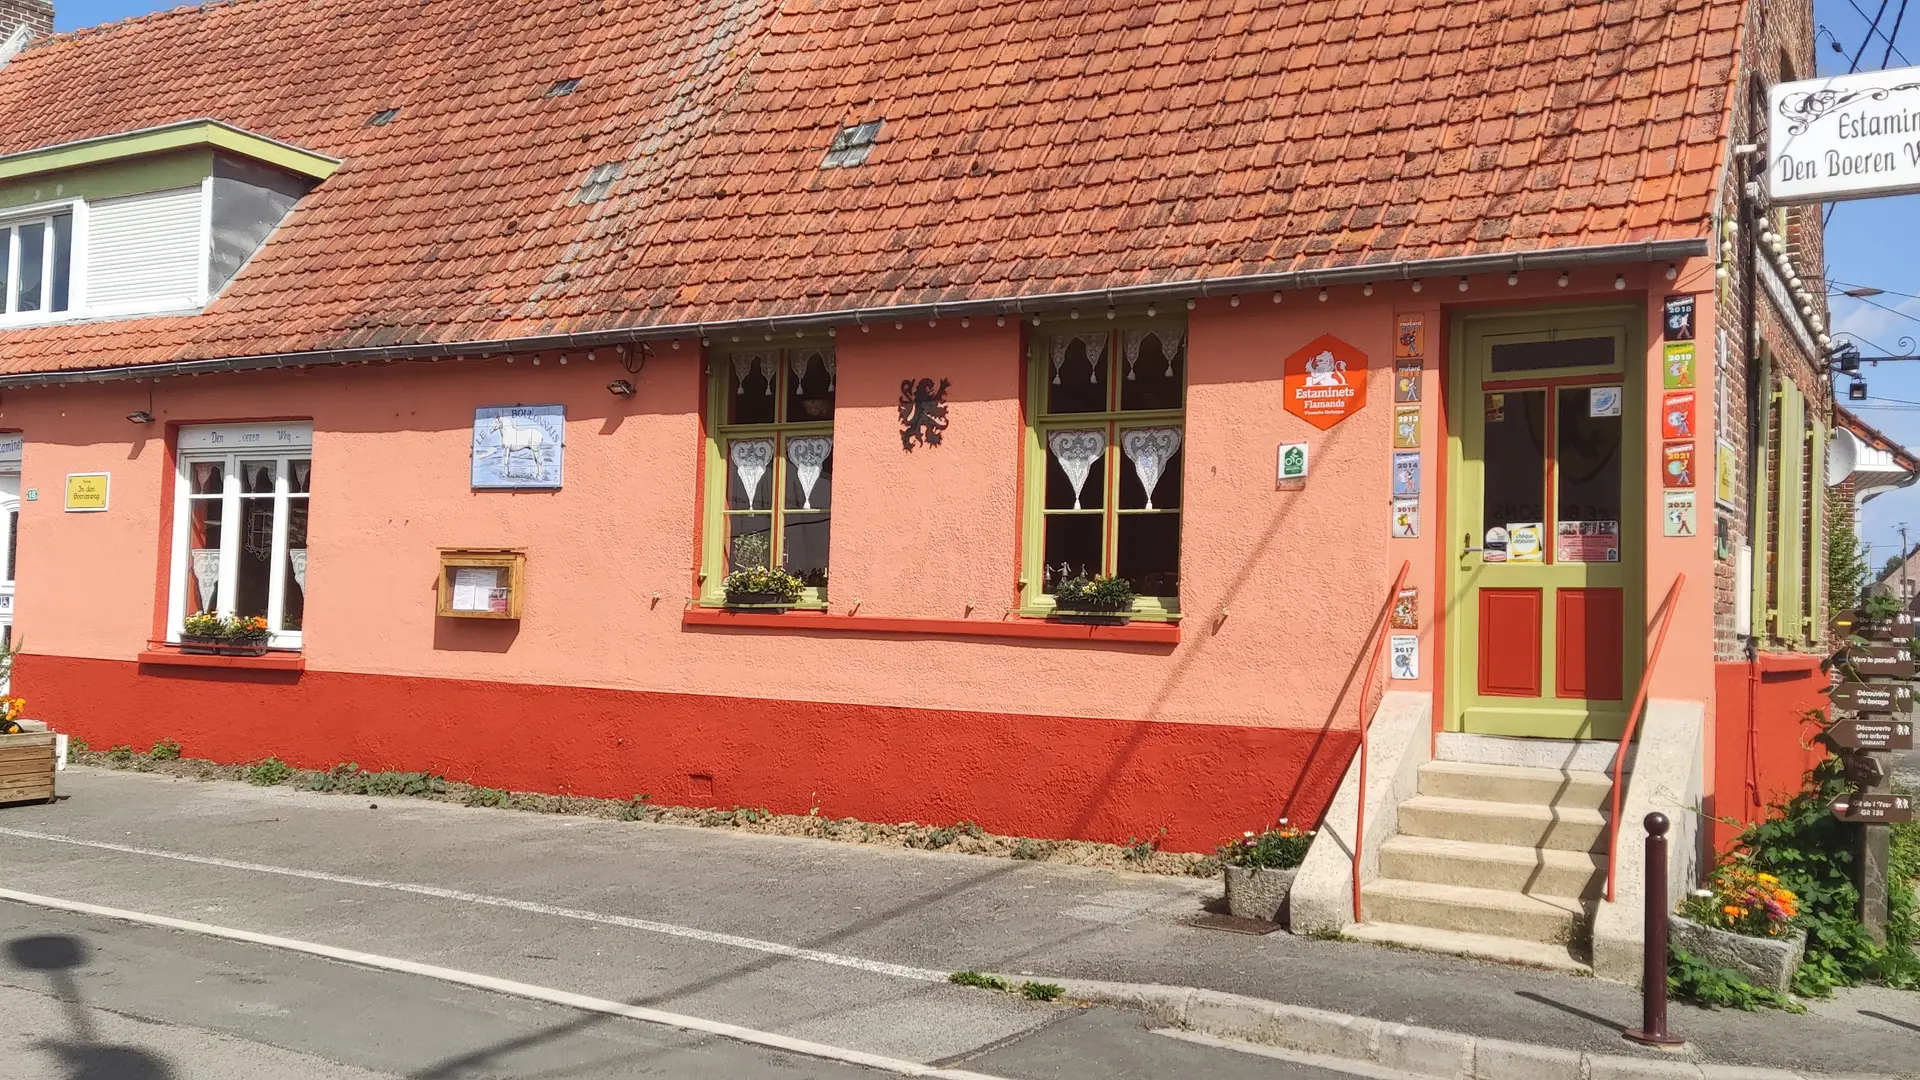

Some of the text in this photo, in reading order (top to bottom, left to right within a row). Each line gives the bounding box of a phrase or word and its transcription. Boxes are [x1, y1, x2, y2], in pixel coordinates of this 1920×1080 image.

[1779, 154, 1818, 182] Den
[1825, 149, 1896, 178] Boeren
[1295, 387, 1354, 399] Estaminets
[1304, 399, 1345, 409] Flamands
[476, 408, 560, 445] LE BOULONNAIS
[211, 431, 224, 443] Den
[1667, 452, 1691, 460] 2021
[28, 490, 37, 498] 18
[1516, 532, 1534, 540] chèque
[1874, 656, 1897, 664] paradis
[1857, 690, 1890, 698] Découverte
[1867, 698, 1889, 706] bocage
[1869, 732, 1890, 740] arbres
